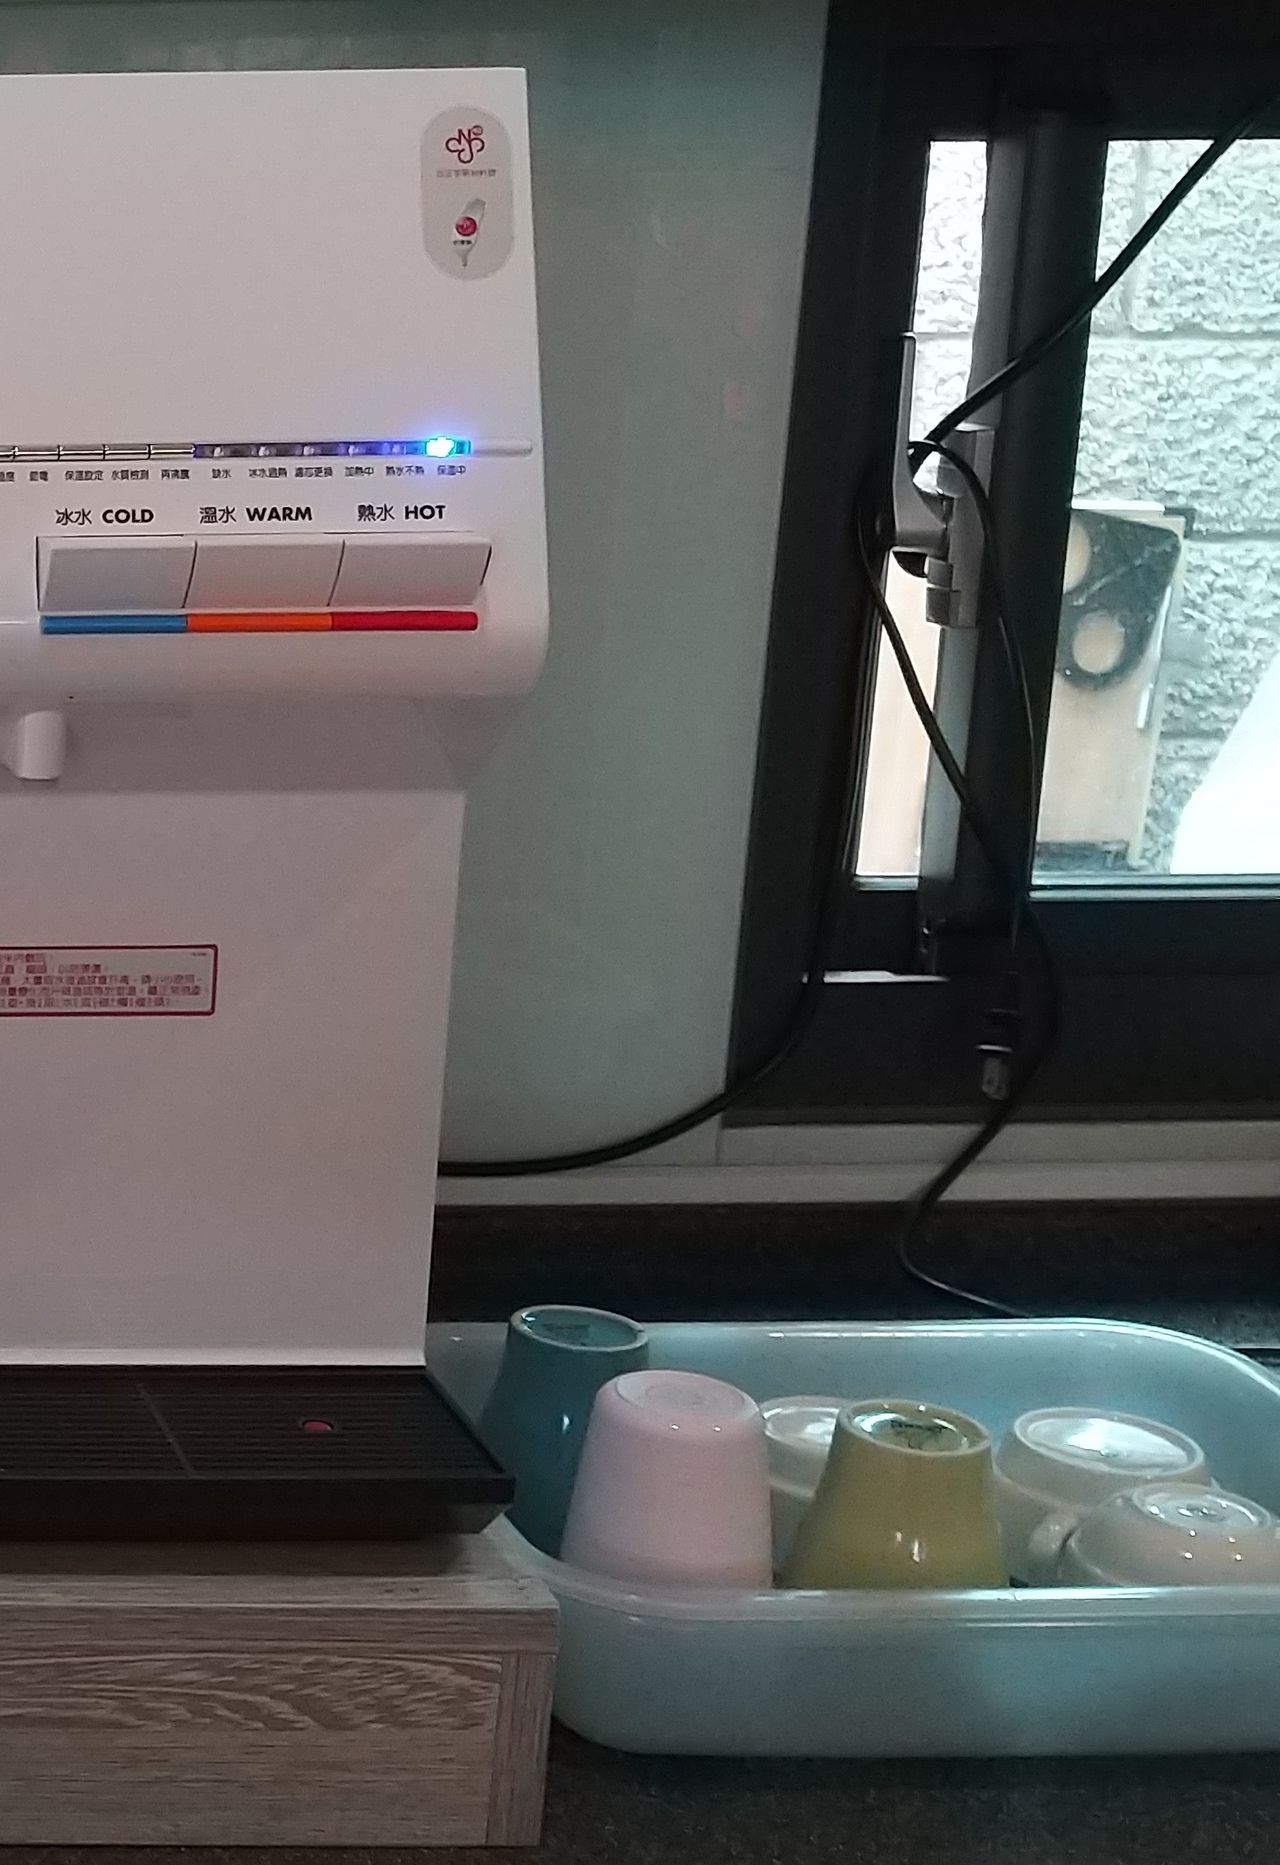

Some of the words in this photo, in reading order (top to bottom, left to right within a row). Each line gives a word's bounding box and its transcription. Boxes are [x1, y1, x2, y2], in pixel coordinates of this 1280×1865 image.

[55, 508, 93, 525] 冰水
[102, 509, 154, 524] COLD
[246, 506, 313, 521] WARM
[357, 504, 395, 522] 熱水
[404, 505, 446, 520] HOT
